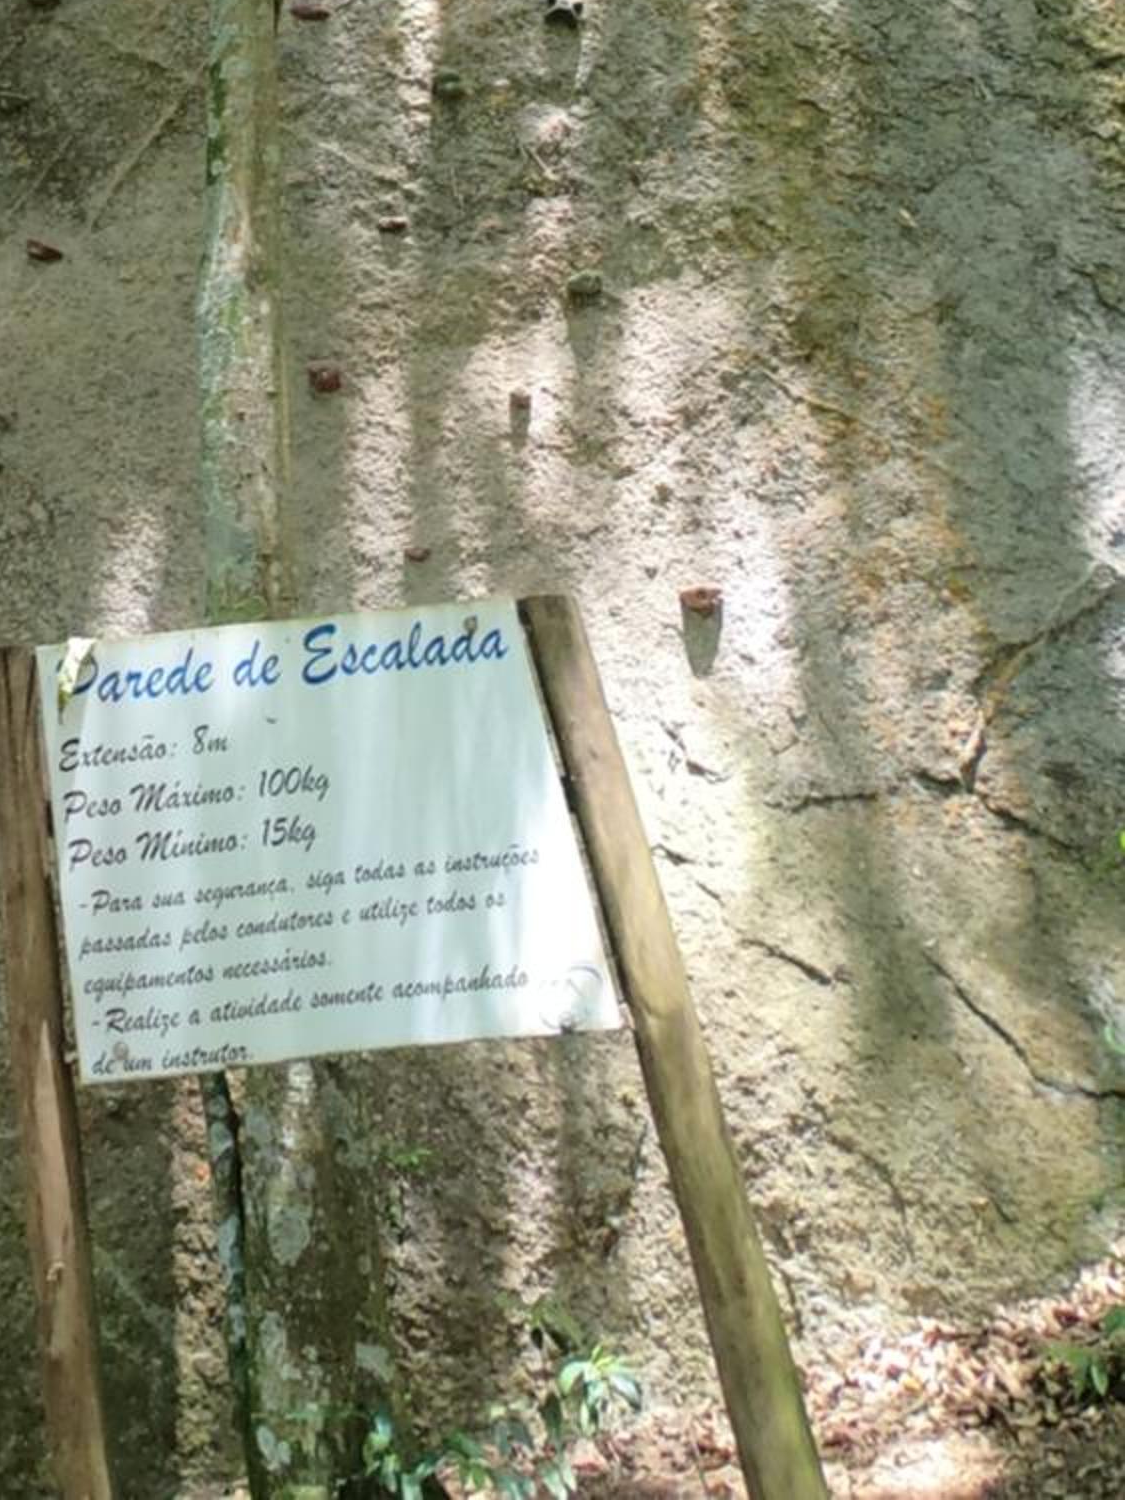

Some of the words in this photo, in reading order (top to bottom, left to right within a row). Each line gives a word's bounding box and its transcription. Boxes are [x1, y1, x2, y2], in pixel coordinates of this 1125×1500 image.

[233, 639, 281, 686] de
[302, 616, 509, 685] Escalada
[58, 733, 178, 773] Extensão:
[192, 724, 228, 755] 8m
[62, 790, 122, 824] Peso
[129, 780, 245, 813] Máximo:
[258, 763, 330, 802] 100kg
[67, 837, 127, 873] Peso
[135, 828, 249, 862] Mínimo:
[262, 814, 316, 853] 15kg
[151, 891, 186, 909] sua
[306, 868, 346, 895] siga
[354, 857, 406, 884] todas
[414, 859, 436, 877] as
[445, 843, 540, 875] instruções
[79, 926, 172, 960] passadas
[179, 919, 228, 951] pelos
[236, 910, 334, 939] condutores
[342, 908, 351, 925] e
[359, 896, 418, 926] utilize
[426, 889, 477, 914] todos
[486, 891, 506, 908] os
[83, 964, 215, 1003] equipamentos
[188, 1008, 201, 1025] a
[210, 987, 302, 1023] atividade
[310, 981, 384, 1008] somente
[391, 963, 529, 1000] acompanhado
[91, 1052, 116, 1076] de
[123, 1057, 153, 1073] um
